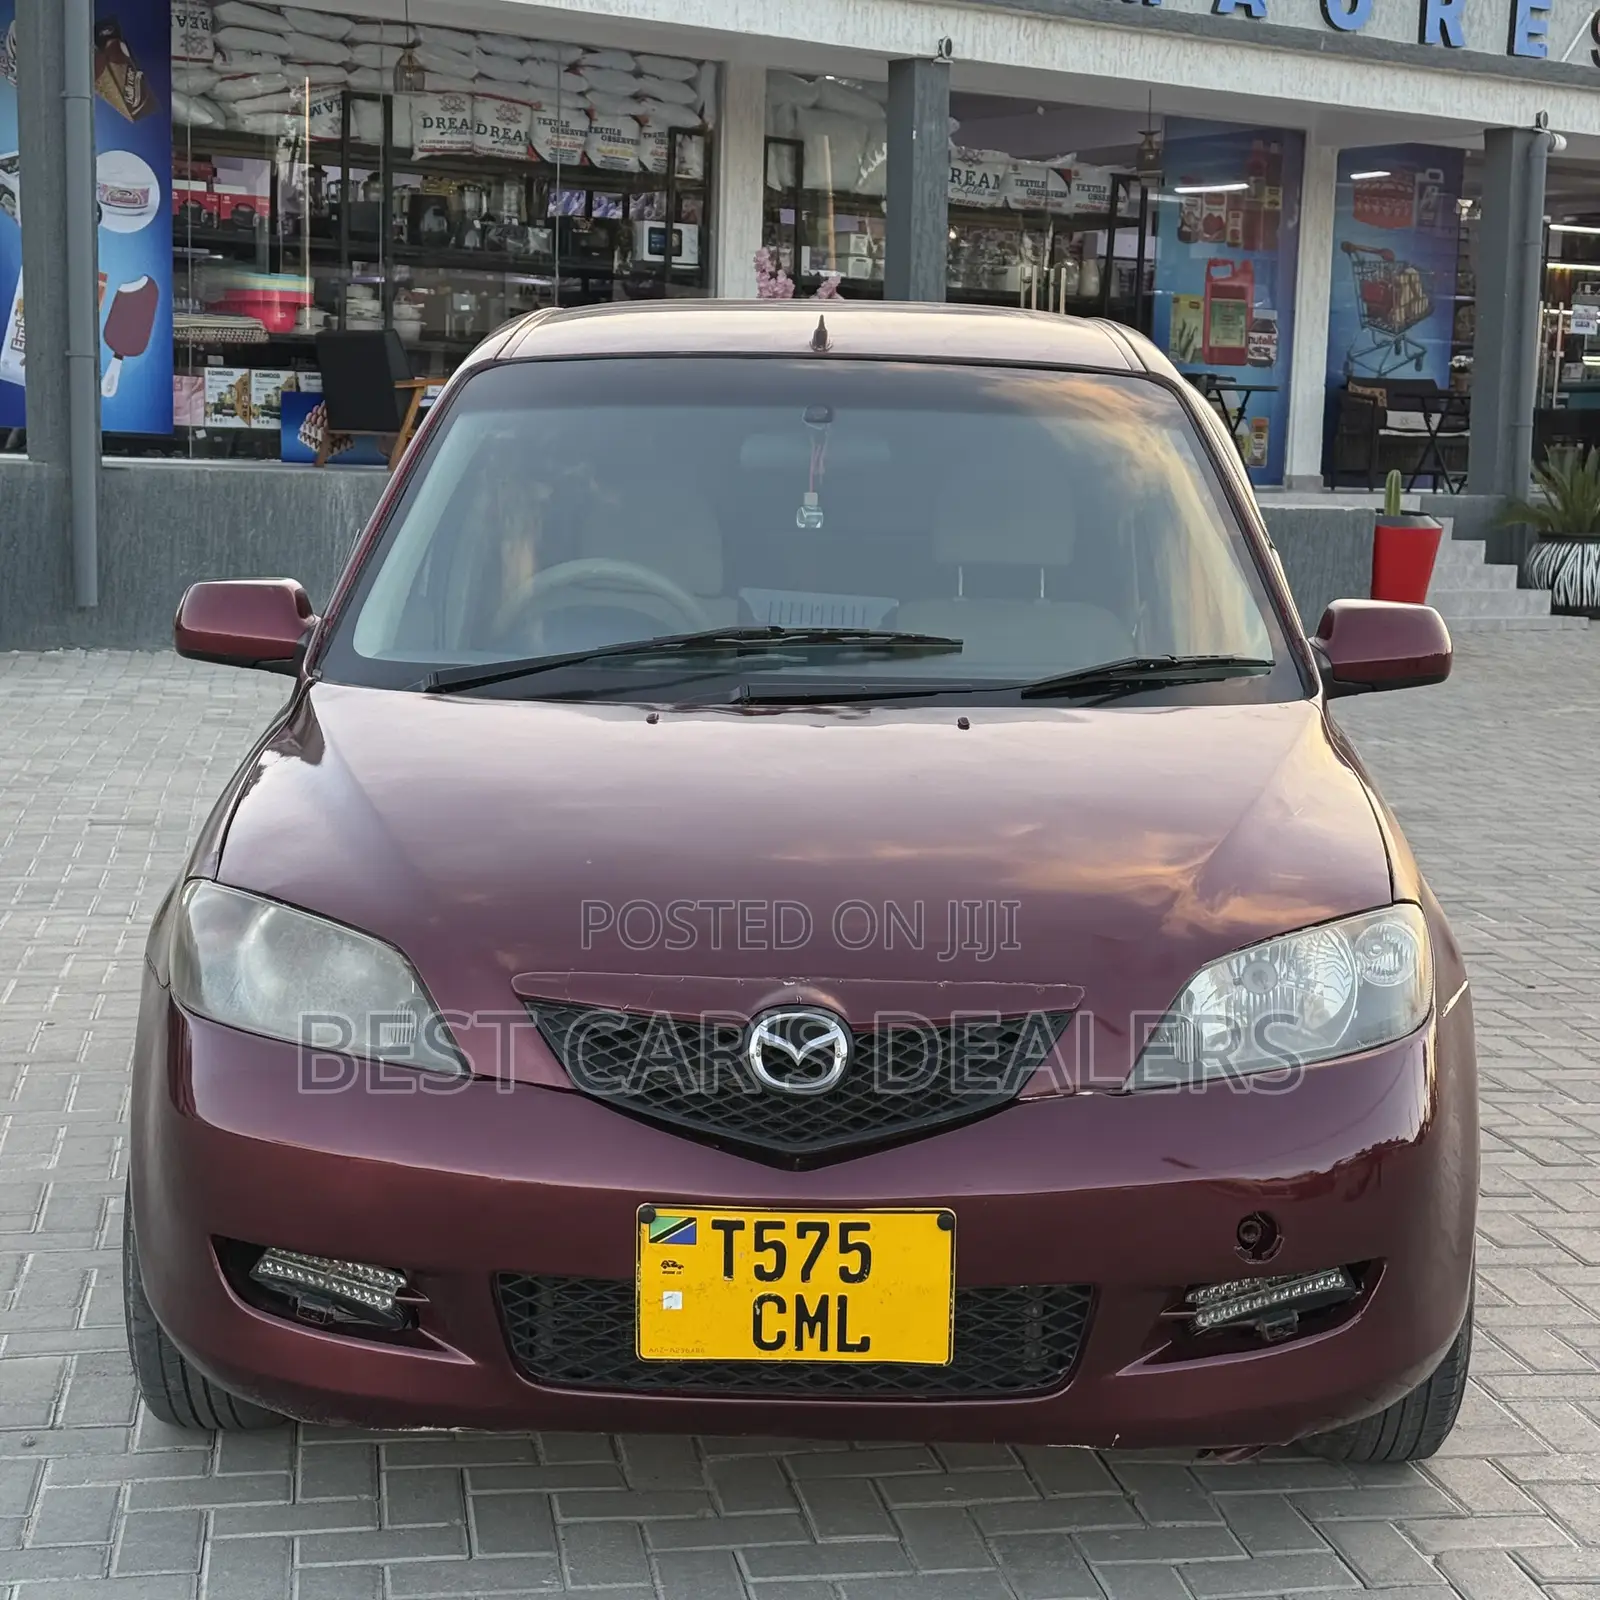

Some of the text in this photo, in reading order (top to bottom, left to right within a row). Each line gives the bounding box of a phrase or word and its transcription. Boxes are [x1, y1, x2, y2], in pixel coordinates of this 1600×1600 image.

[174, 15, 213, 31] REA
[422, 116, 472, 130] DREA
[711, 1218, 872, 1284] T575
[752, 1292, 871, 1352] CML
